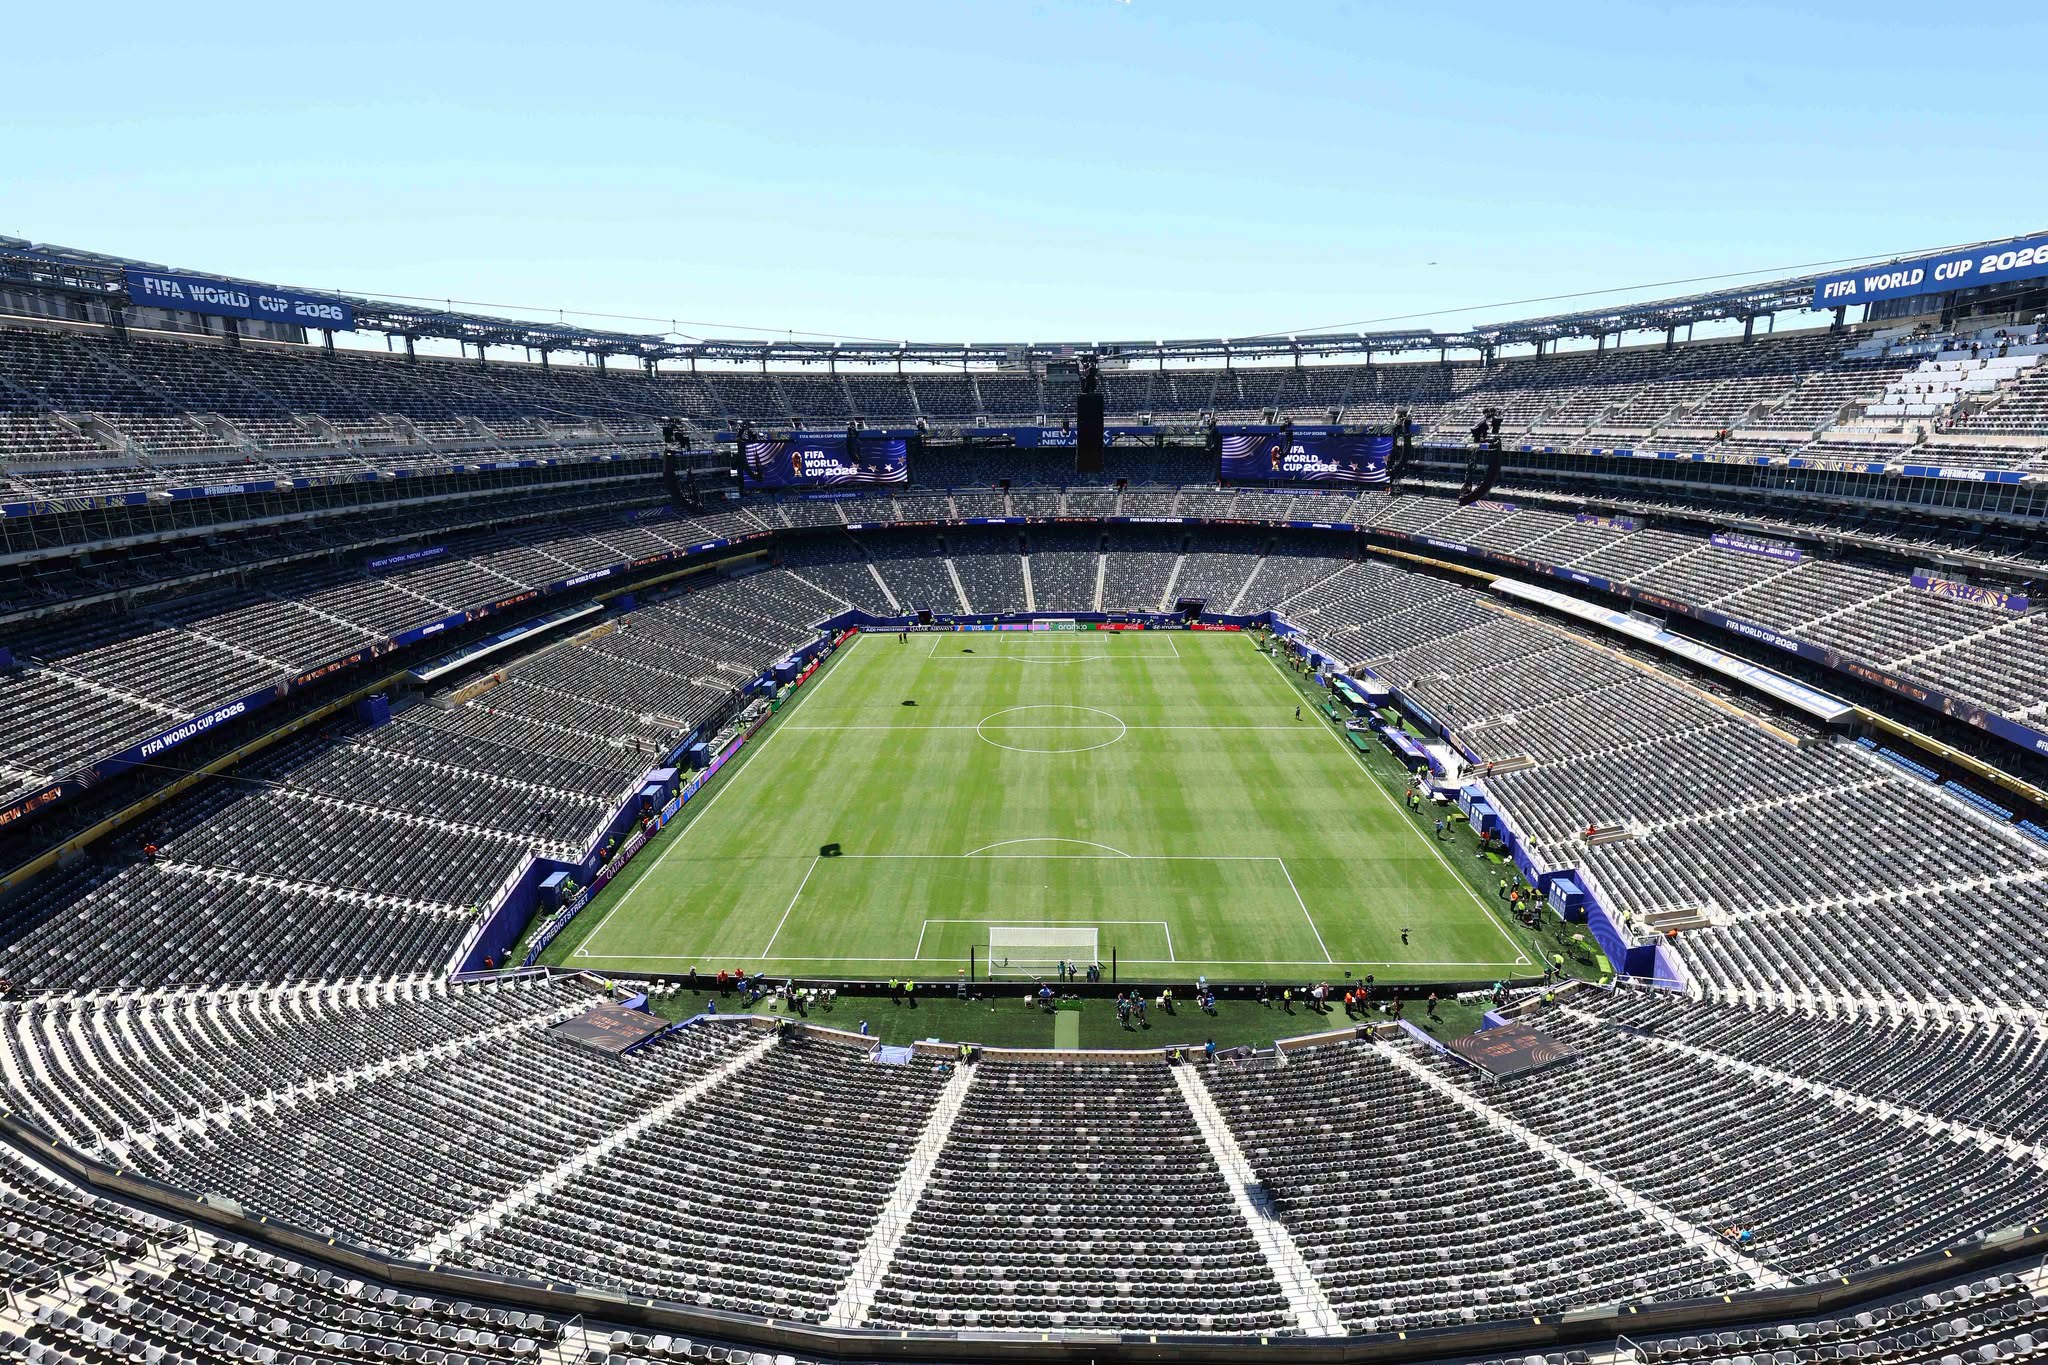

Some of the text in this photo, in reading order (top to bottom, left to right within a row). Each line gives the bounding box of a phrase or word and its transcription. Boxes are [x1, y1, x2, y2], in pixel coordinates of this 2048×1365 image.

[1823, 244, 2048, 299] FIFA WORLD CUP 2026
[143, 277, 344, 321] FIFA WORLD CUP 2026
[804, 451, 825, 459] FIFA
[805, 459, 839, 467] WORLD
[1284, 454, 1318, 462] WORLD
[805, 468, 858, 477] CUP 2026
[1283, 463, 1337, 472] CUP 2026
[1730, 539, 1748, 549] YORK
[372, 547, 444, 568] NEW YORK NEW JERSEY
[575, 575, 589, 585] WORLD
[589, 572, 597, 581] CUP
[597, 568, 611, 579] 2026
[1725, 619, 1798, 651] FIFA WORLD CUP 2026
[141, 702, 246, 757] FIFA WORLD CUP 2026
[606, 857, 625, 879] QATAR
[530, 894, 589, 963] ADI PREDICTSTREET
